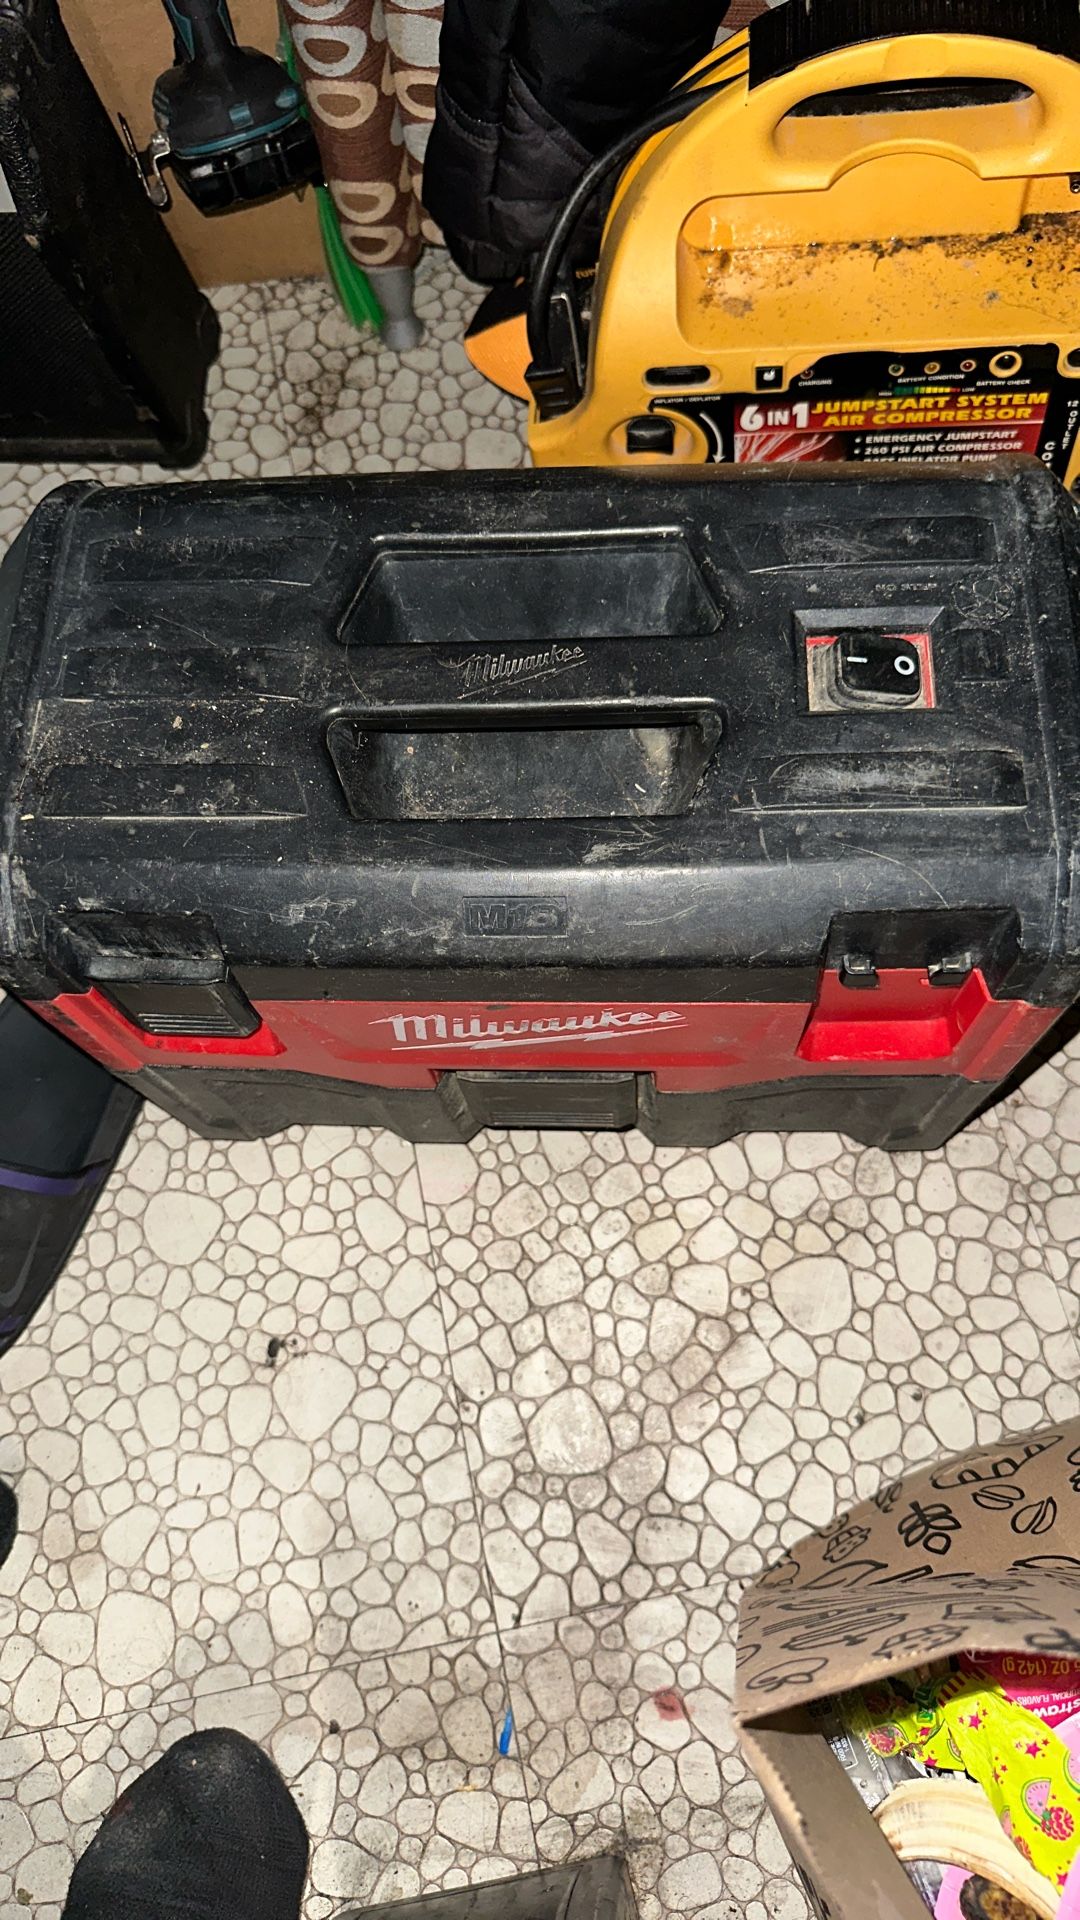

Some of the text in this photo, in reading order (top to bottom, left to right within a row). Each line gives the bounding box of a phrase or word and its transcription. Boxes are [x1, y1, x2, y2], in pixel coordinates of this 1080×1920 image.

[811, 392, 1049, 415] JUMPSTART SYSTEM
[740, 402, 809, 432] 6 IN 1
[822, 407, 1032, 427] AIR COMPRESSOR
[865, 430, 1018, 444] EMERGENCY JUMPSTART
[1062, 410, 1079, 450] OUTLET
[864, 441, 1024, 455] 260 PSI AIR COMPRESSOR
[961, 454, 998, 463] PUMP
[446, 644, 587, 693] Milwaukee
[367, 1007, 688, 1046] Milwaukee
[1002, 1656, 1015, 1675] g)
[1018, 1658, 1047, 1676] (142
[1051, 1660, 1070, 1675] OZ
[1016, 1693, 1050, 1706] FLAVORS
